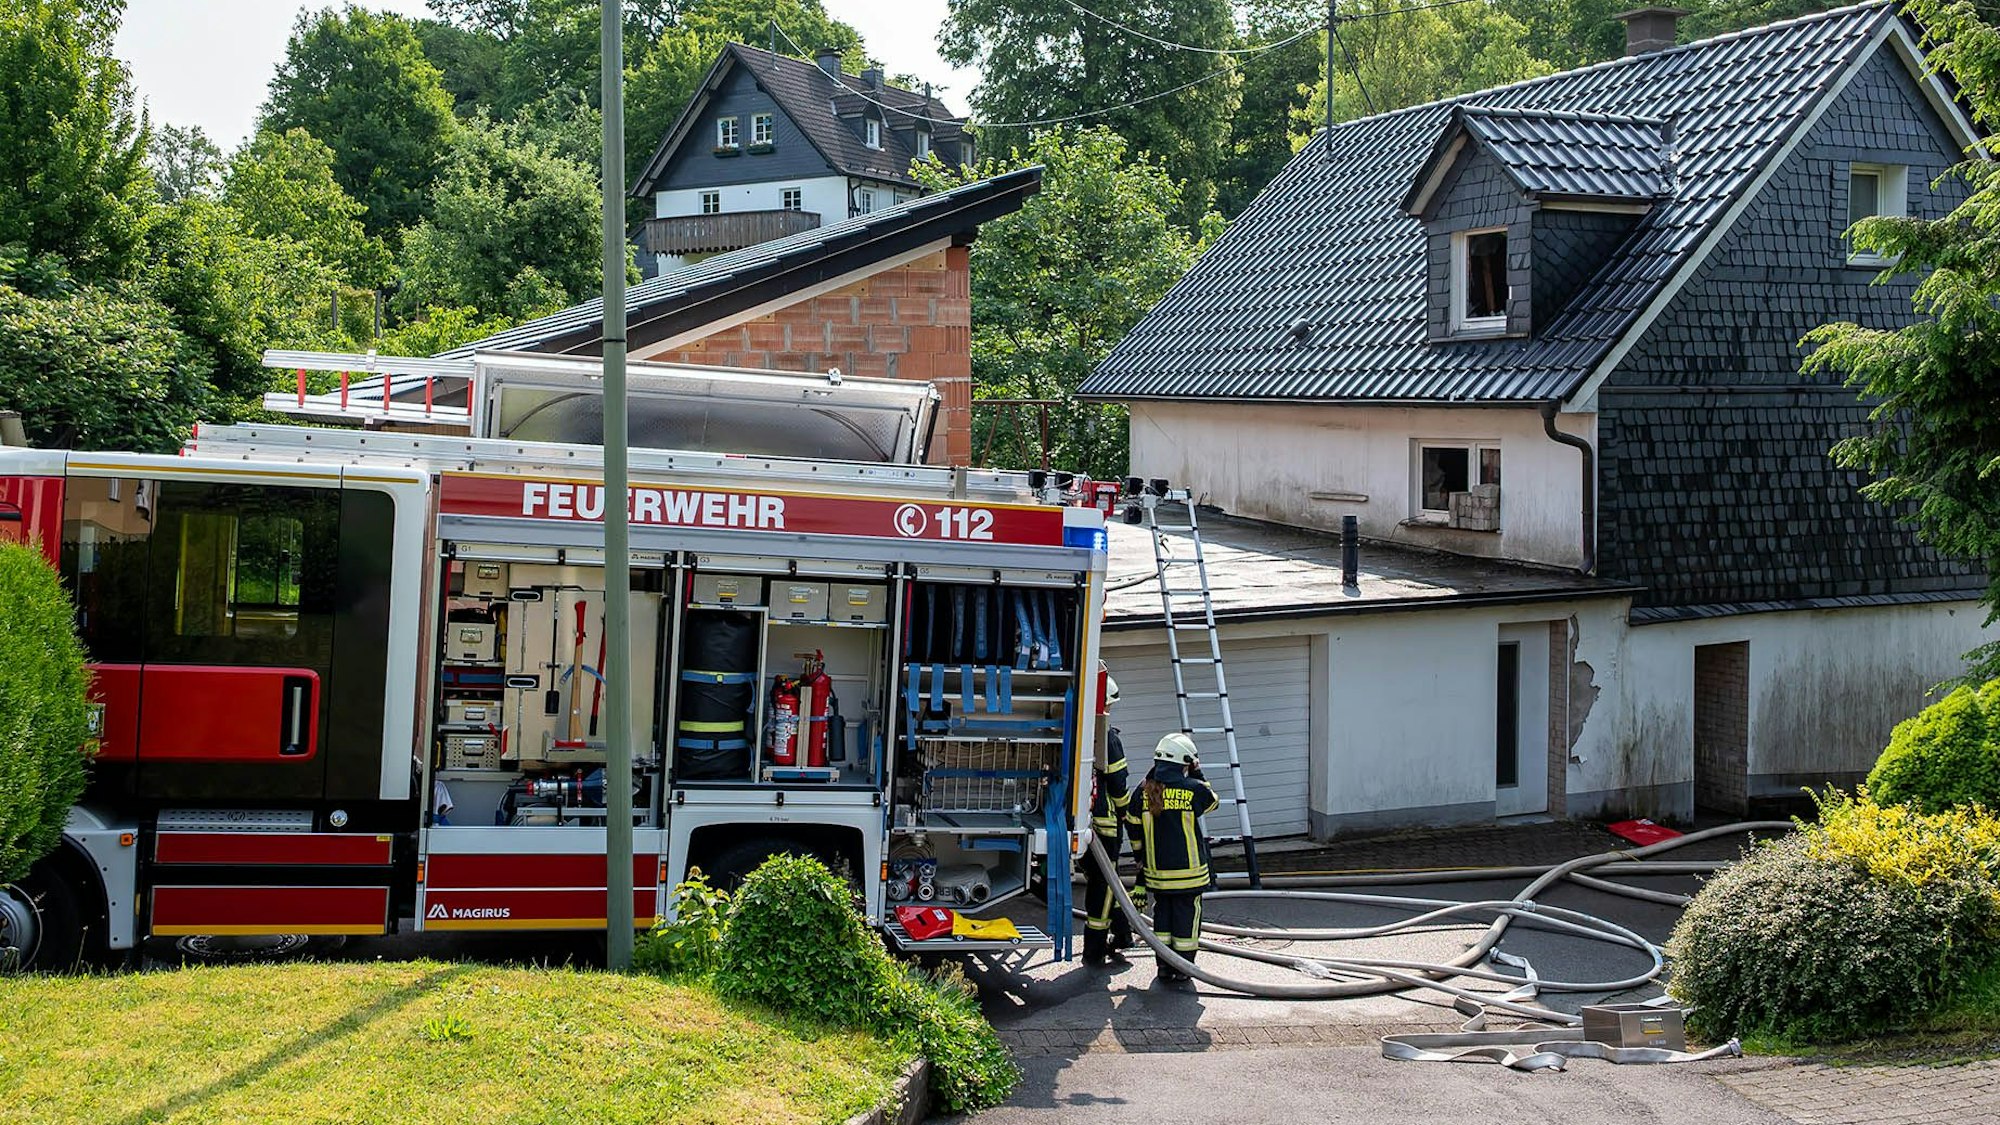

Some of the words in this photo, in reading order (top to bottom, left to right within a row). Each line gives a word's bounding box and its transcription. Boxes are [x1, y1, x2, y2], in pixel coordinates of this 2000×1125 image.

[522, 483, 785, 529] FEURWEHR
[935, 507, 994, 540] 112
[452, 908, 510, 918] MAGIRUS
